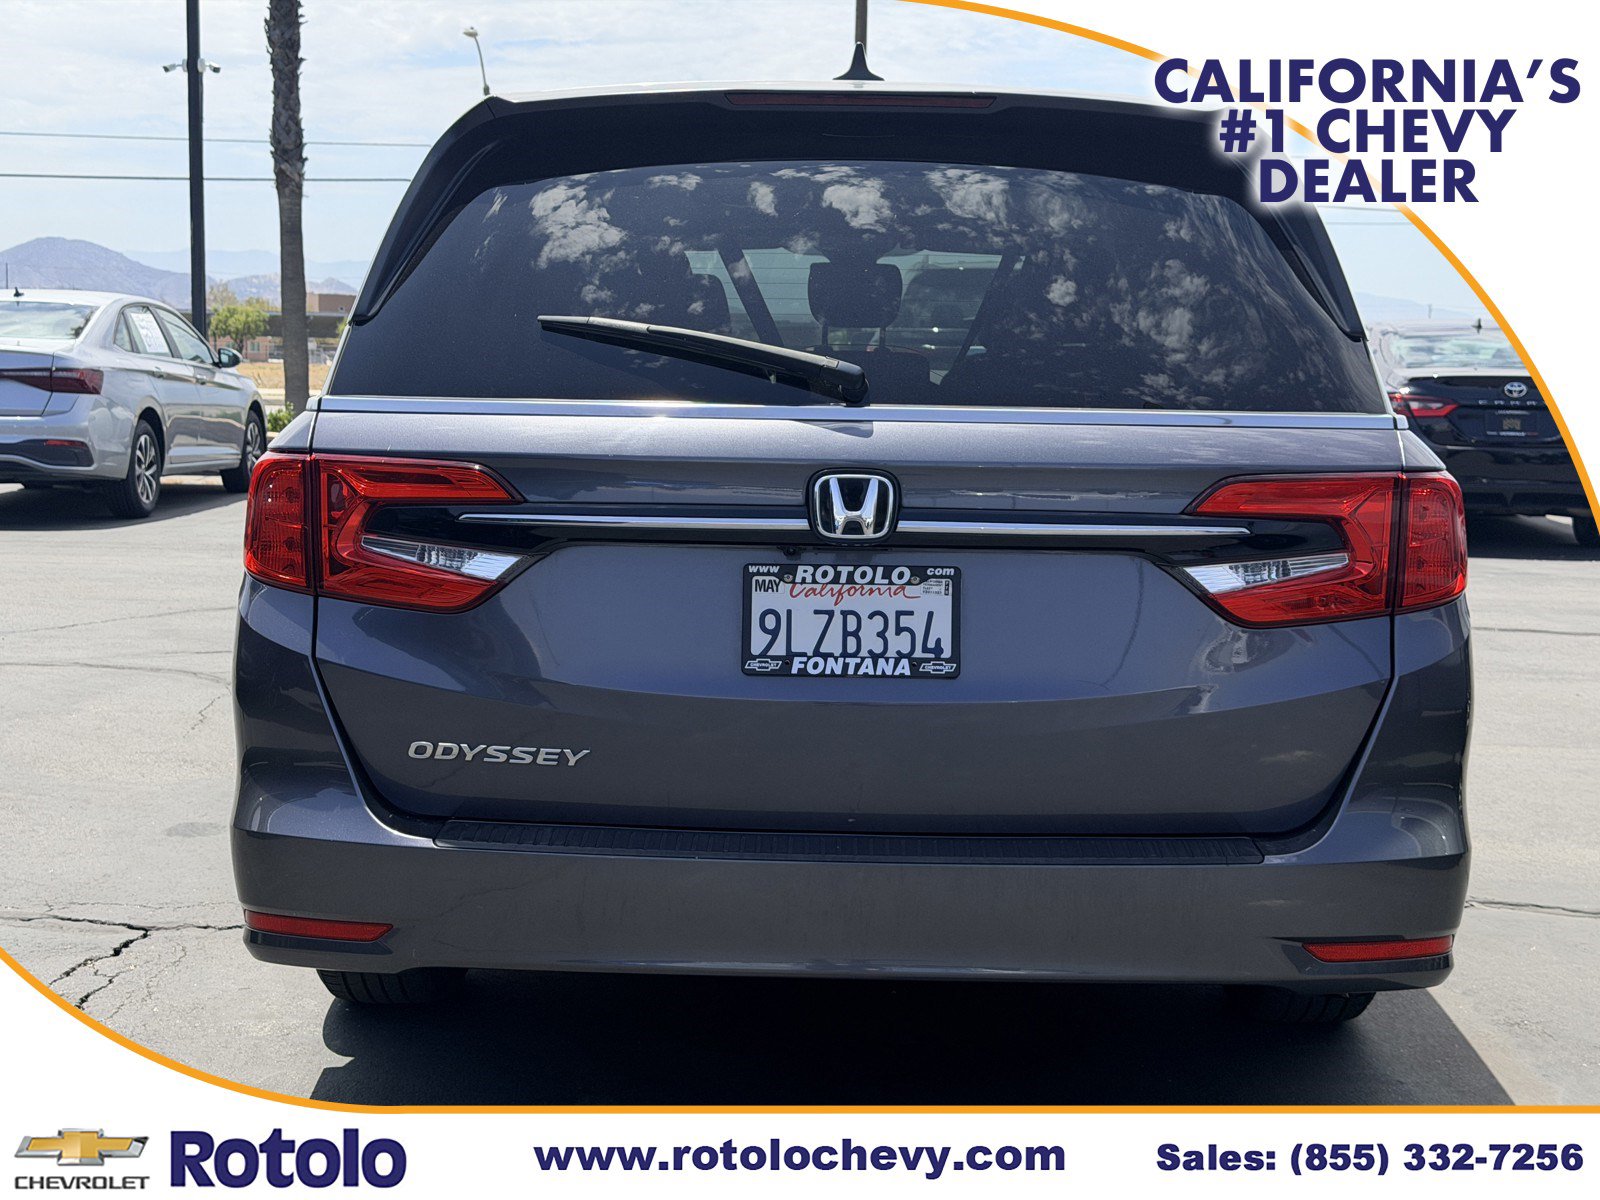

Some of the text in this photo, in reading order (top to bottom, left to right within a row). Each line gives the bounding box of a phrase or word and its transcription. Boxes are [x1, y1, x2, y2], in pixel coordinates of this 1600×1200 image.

[748, 565, 955, 585] www ROTOLO com
[754, 578, 781, 593] MAY
[789, 583, 921, 607] California
[758, 608, 944, 658] 9LZB354
[791, 656, 911, 676] FONTANA
[407, 741, 591, 767] ODYSSEY
